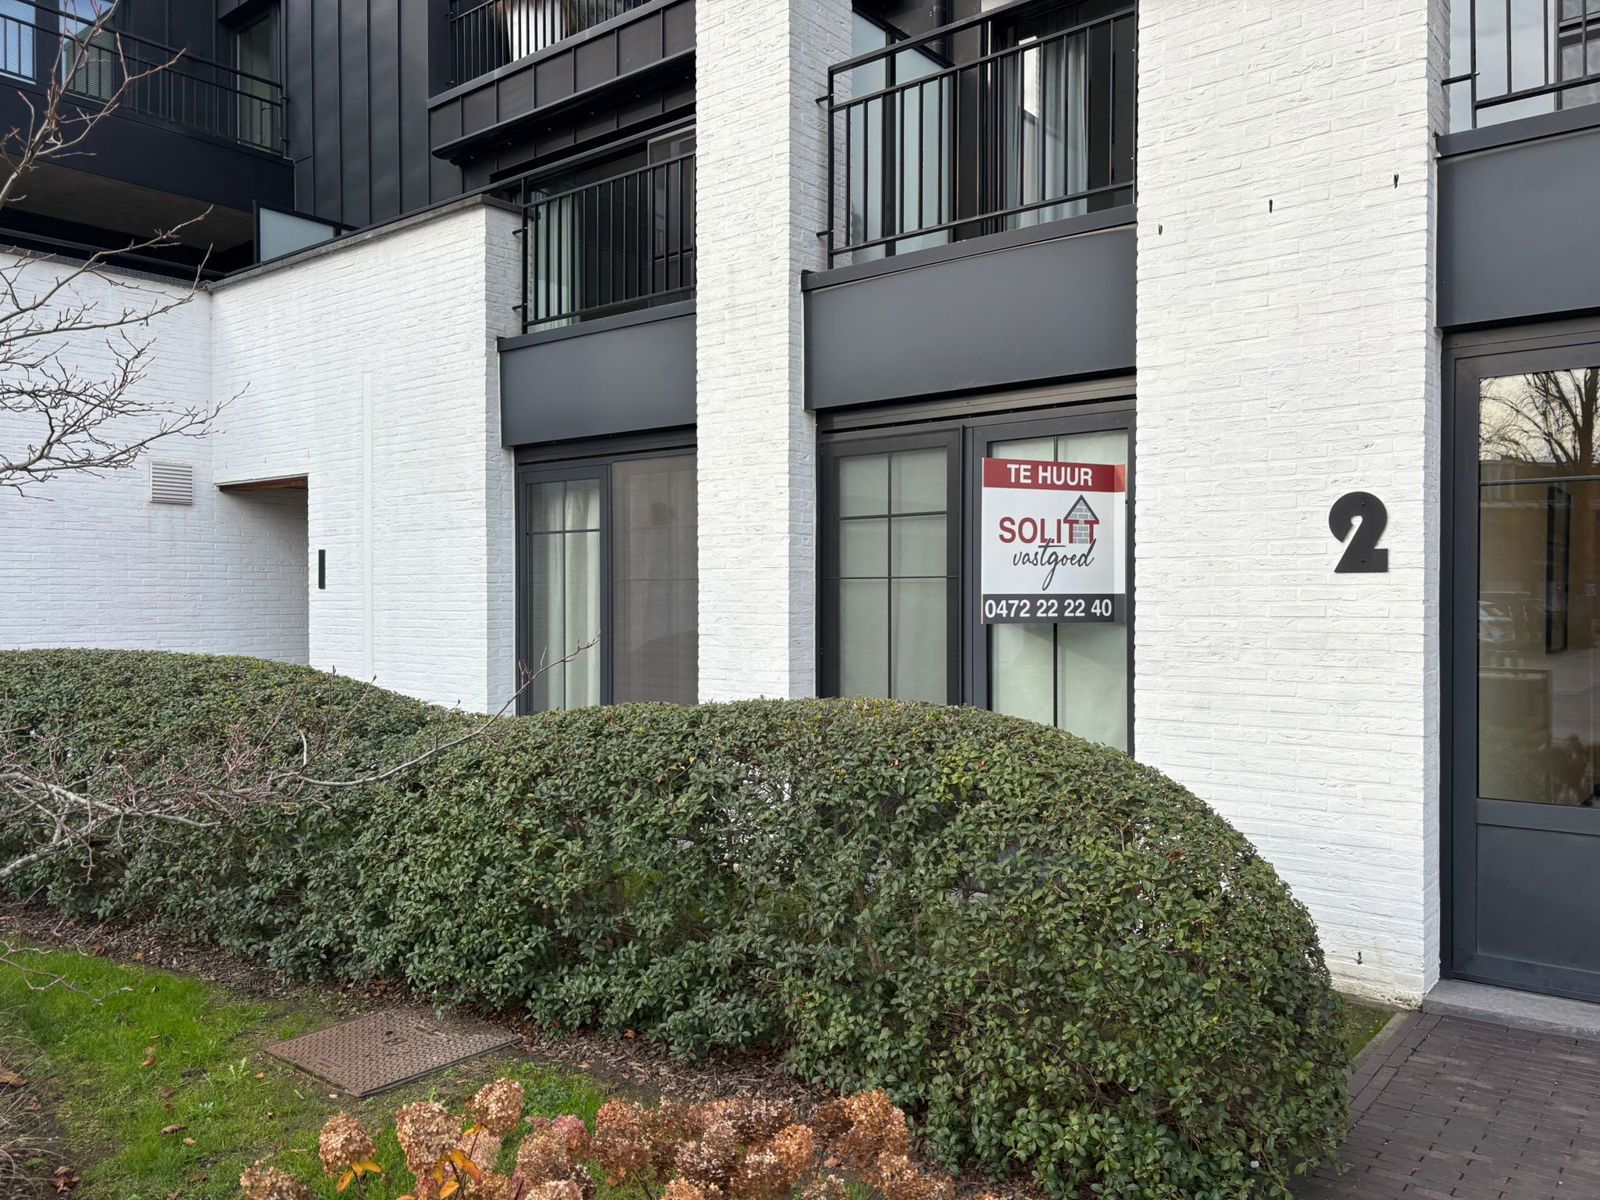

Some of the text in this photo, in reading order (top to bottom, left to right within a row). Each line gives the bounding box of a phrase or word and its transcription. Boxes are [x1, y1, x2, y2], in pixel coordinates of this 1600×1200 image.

[1007, 464, 1093, 486] TE HUUR
[999, 516, 1100, 544] SOLITT
[1328, 491, 1389, 573] 2
[1013, 538, 1097, 591] vastgoed
[985, 599, 1112, 618] 0472 22 22 40
